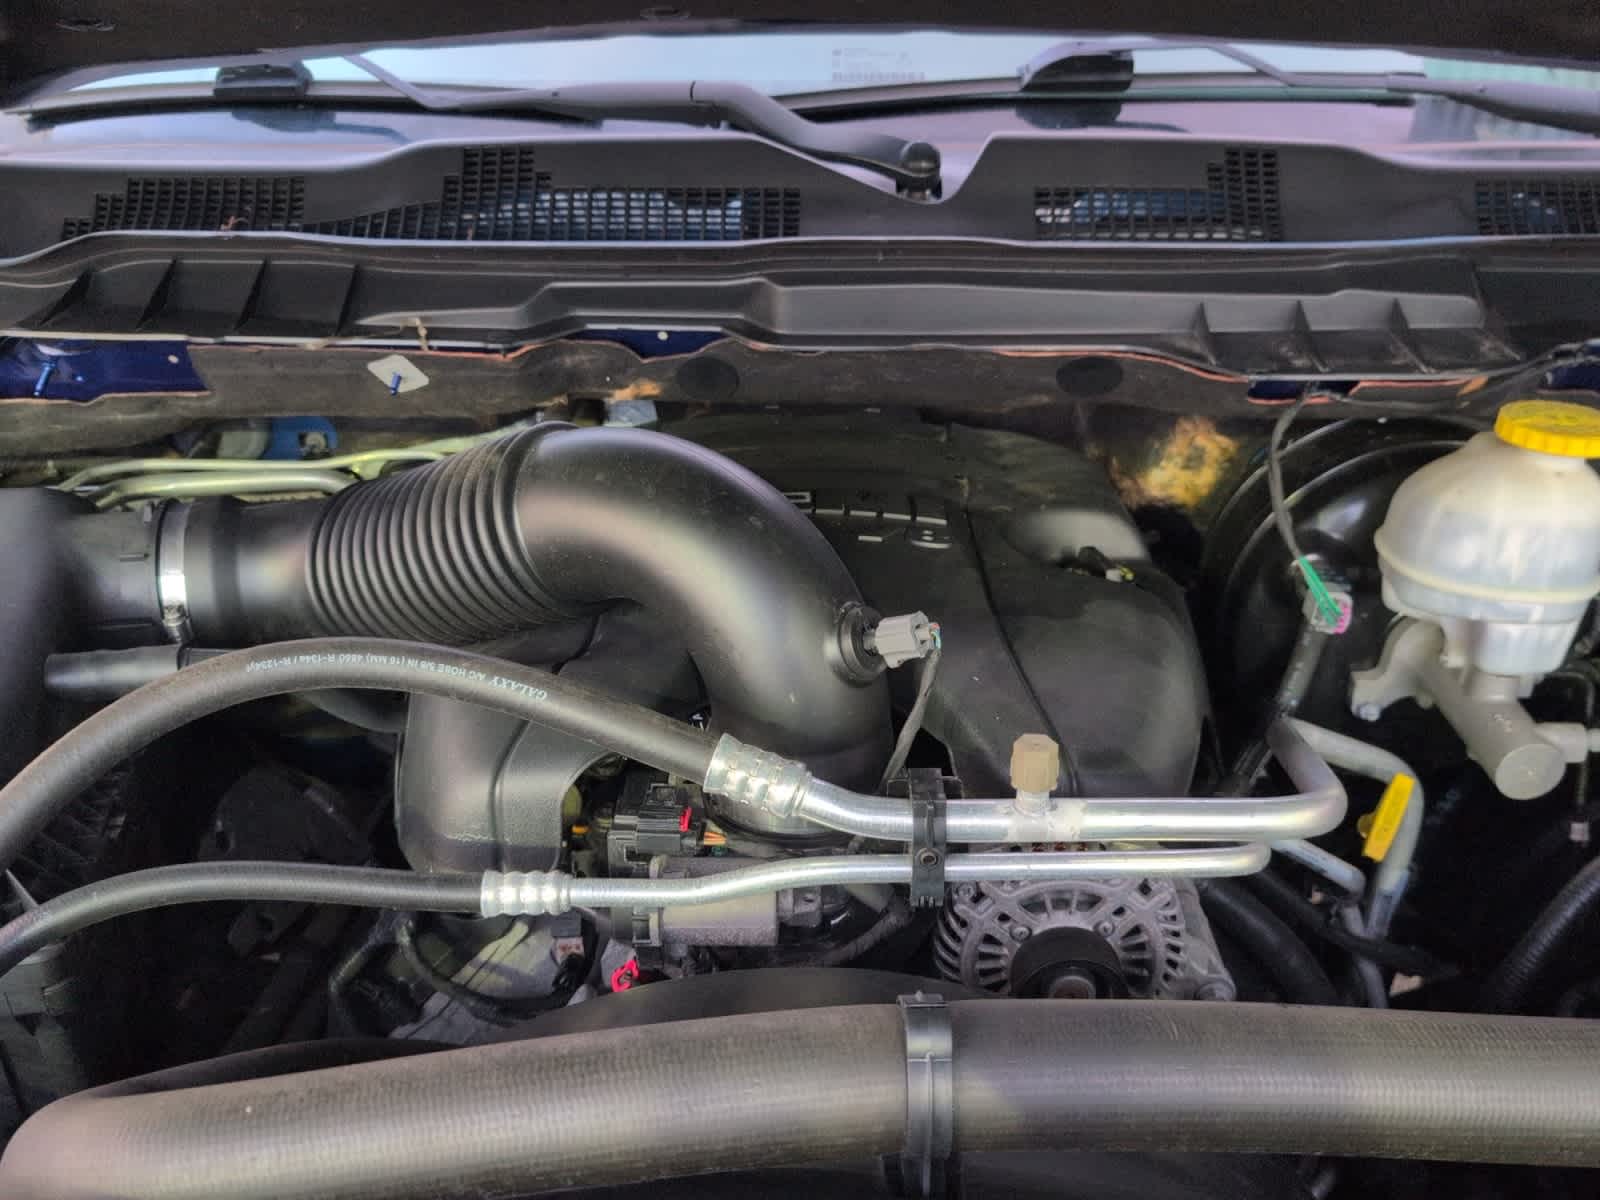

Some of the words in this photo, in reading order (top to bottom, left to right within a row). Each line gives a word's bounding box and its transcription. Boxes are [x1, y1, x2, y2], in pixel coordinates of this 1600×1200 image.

[438, 663, 466, 676] HOSE
[468, 670, 486, 681] A/C
[488, 675, 547, 700] GALAXY
